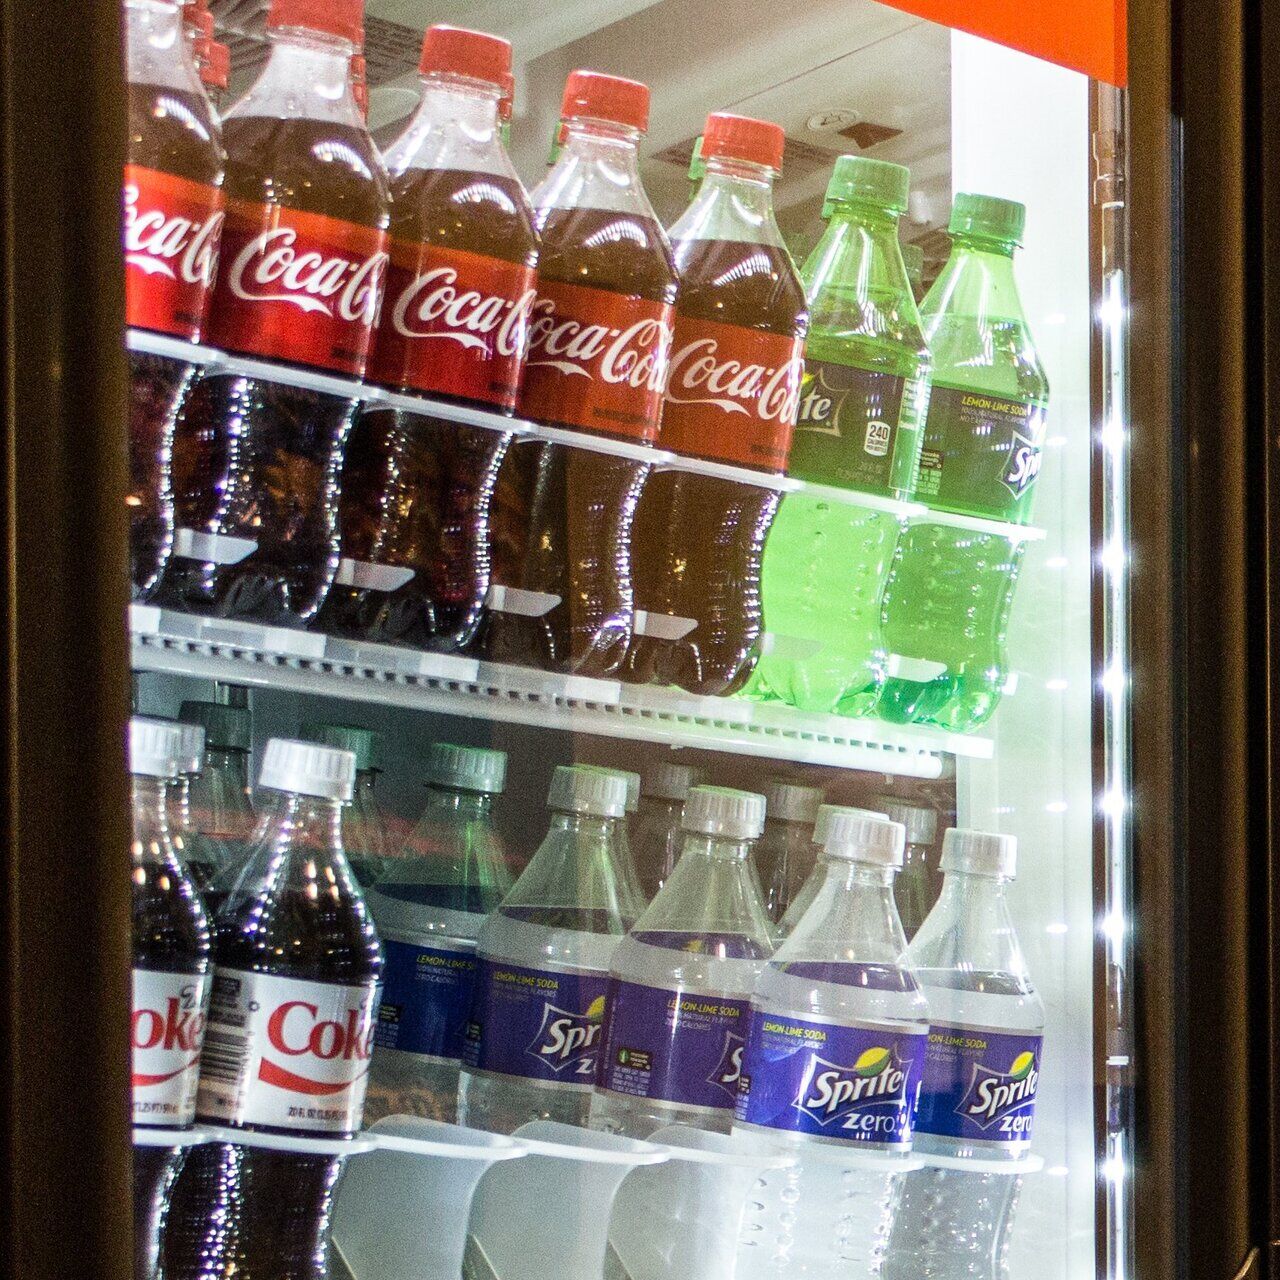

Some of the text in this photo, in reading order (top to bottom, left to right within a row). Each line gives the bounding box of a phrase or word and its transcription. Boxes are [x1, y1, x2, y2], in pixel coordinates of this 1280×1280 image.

[868, 423, 889, 441] 240
[131, 997, 205, 1052] oke
[806, 1061, 904, 1114] Sprite
[968, 1064, 1039, 1119] Sprite
[841, 1112, 896, 1133] zero
